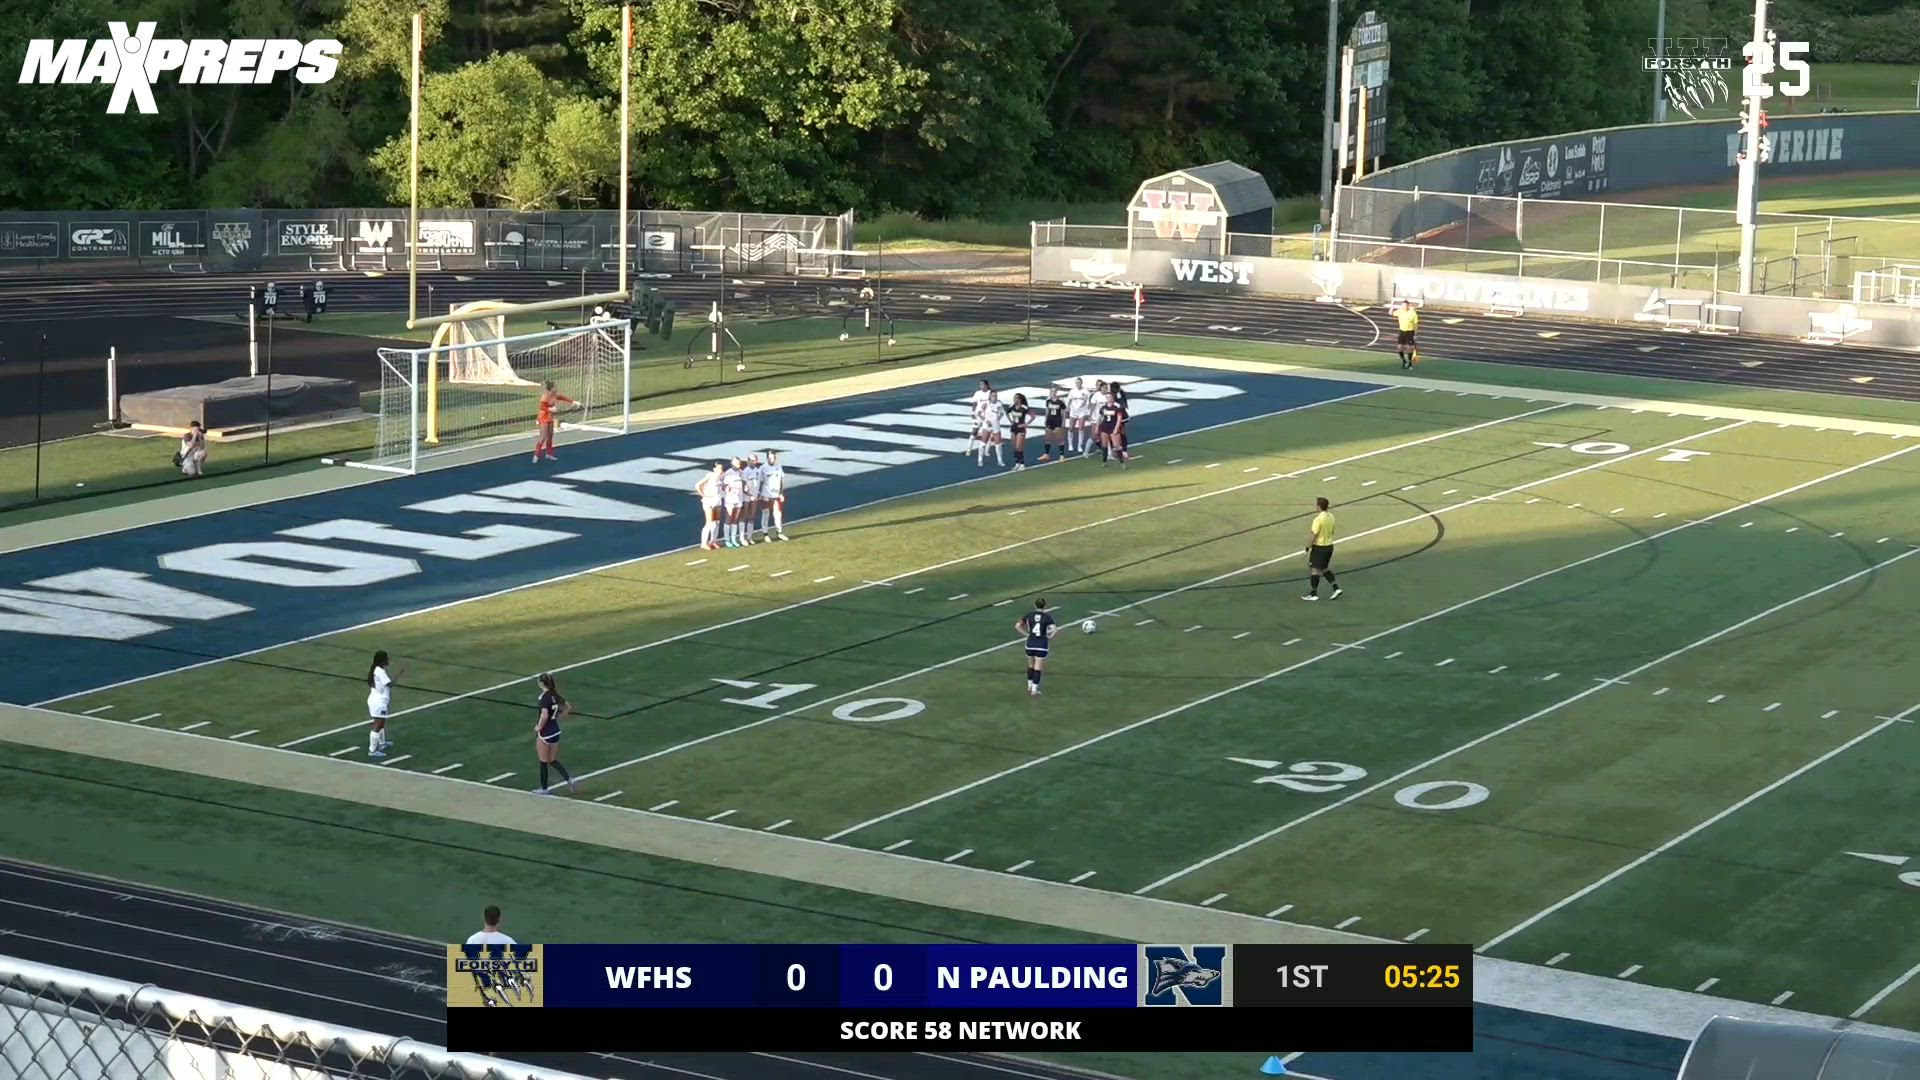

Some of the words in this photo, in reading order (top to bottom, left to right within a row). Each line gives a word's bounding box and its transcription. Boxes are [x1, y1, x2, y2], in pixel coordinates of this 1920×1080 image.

[1726, 127, 1845, 168] WVERINE
[285, 223, 329, 235] STYLE
[152, 231, 185, 248] MILL
[1170, 258, 1254, 285] WEST
[264, 295, 277, 305] 70
[313, 294, 326, 304] 70
[1031, 622, 1041, 637] 4
[550, 704, 560, 720] 7
